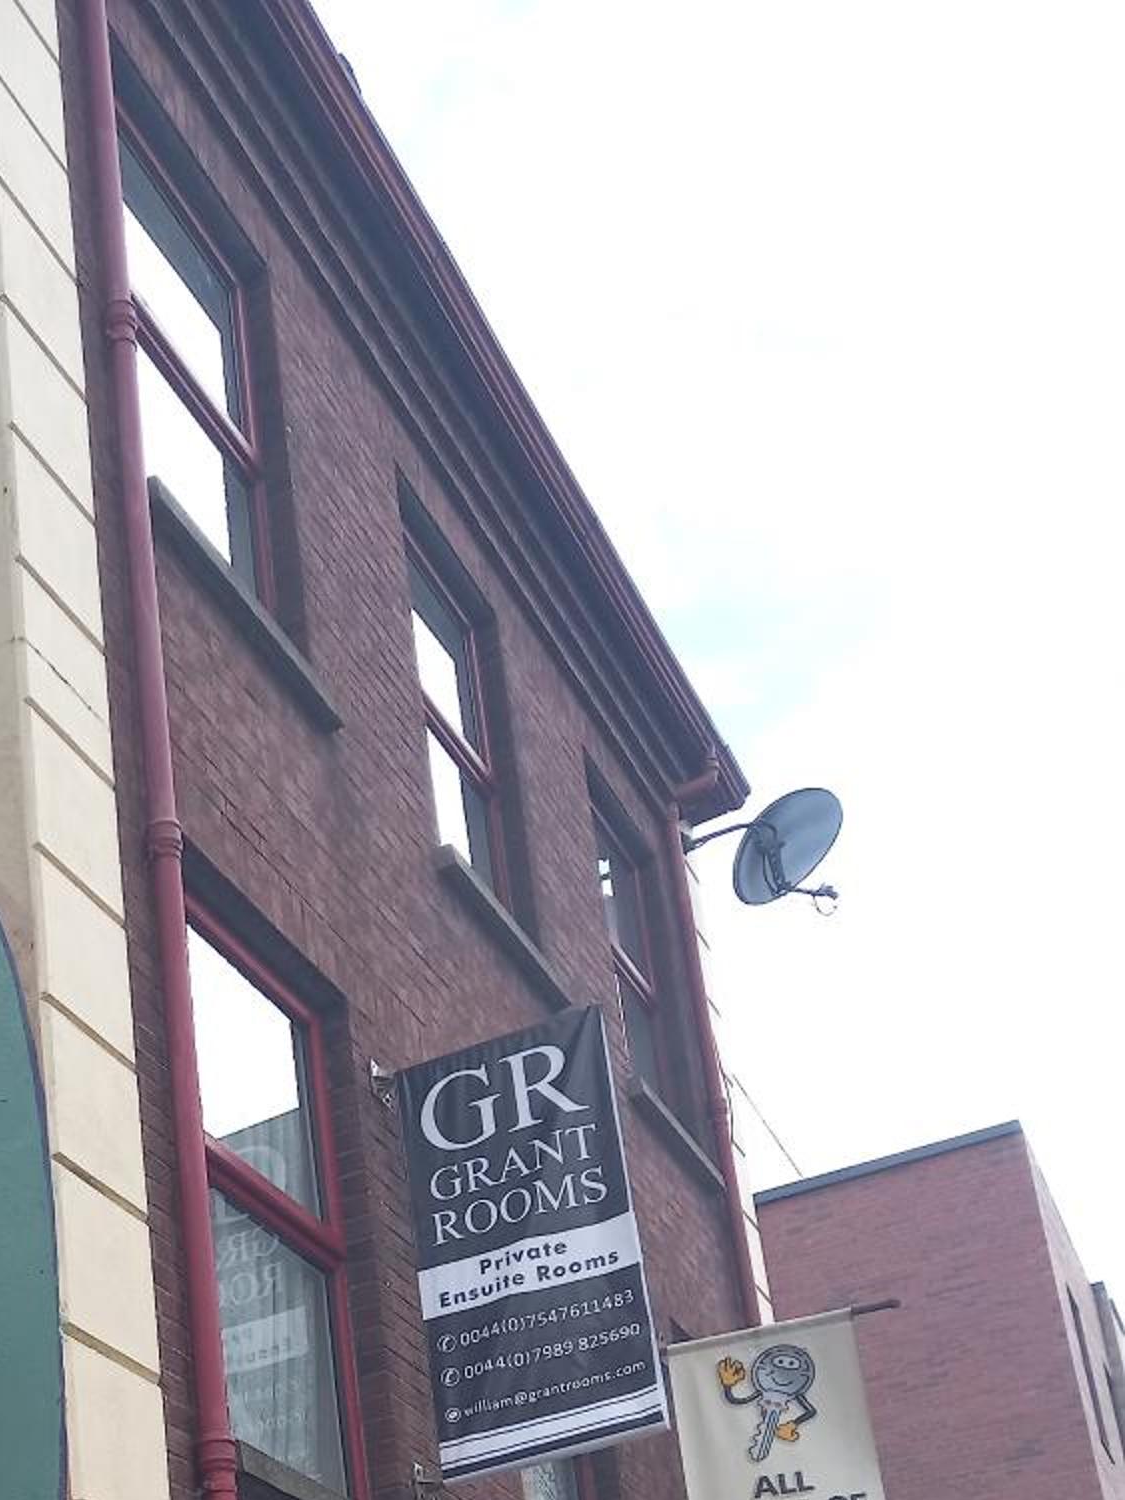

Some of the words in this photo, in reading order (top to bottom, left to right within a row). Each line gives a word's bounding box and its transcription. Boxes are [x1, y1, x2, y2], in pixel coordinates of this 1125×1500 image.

[421, 1044, 590, 1150] GR
[430, 1124, 597, 1201] GRANT
[432, 1166, 607, 1246] ROOMS
[439, 1272, 525, 1308] Ensuite
[536, 1250, 619, 1282] Rooms
[479, 1240, 568, 1275] Private
[754, 1471, 815, 1498] ALL
